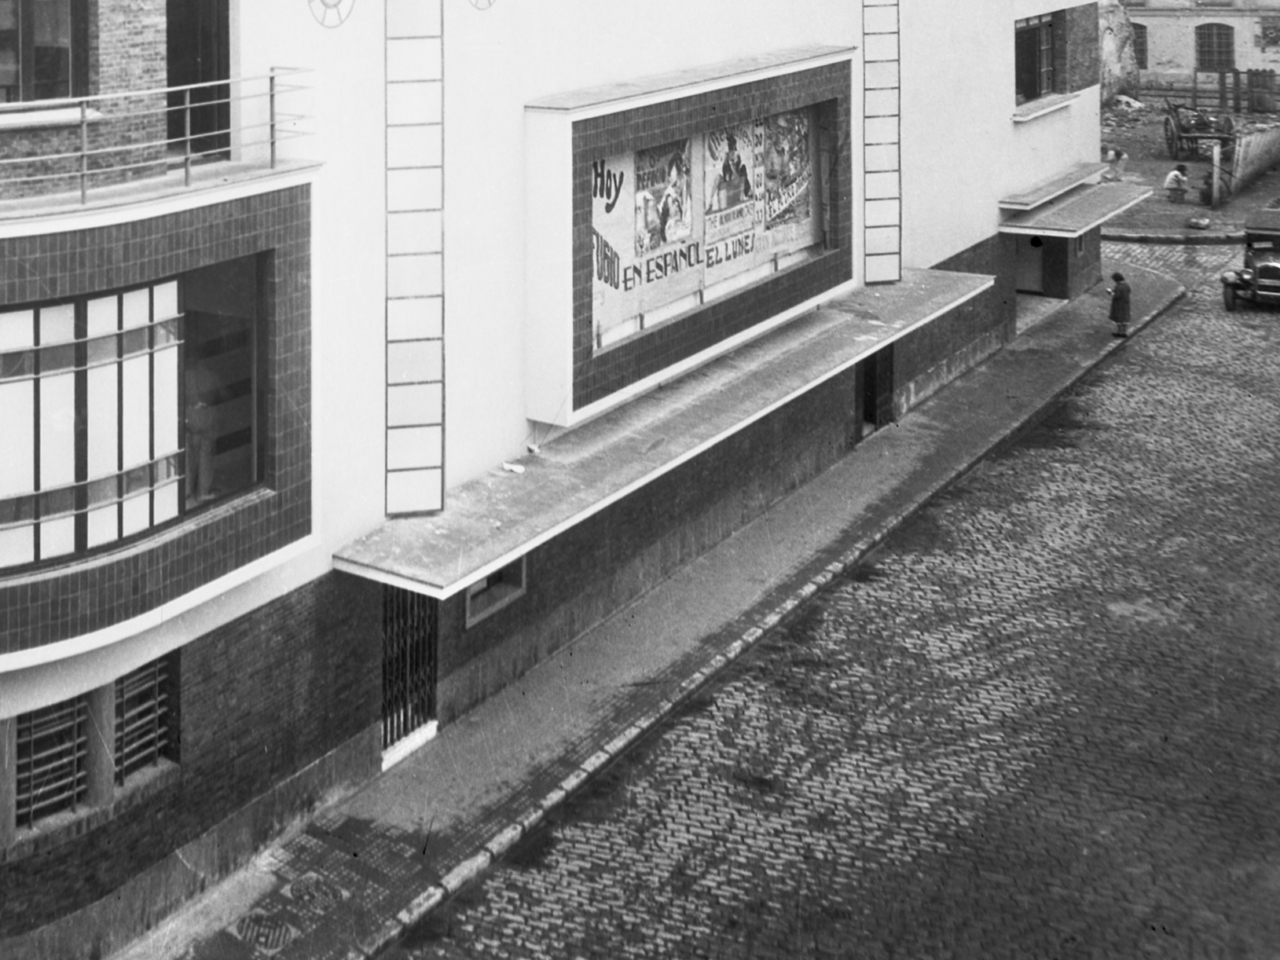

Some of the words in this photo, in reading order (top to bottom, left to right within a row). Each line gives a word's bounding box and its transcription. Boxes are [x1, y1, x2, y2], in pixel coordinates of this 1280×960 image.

[592, 159, 624, 214] Hoy
[623, 262, 642, 292] EN
[646, 240, 704, 284] ESPAÑOL
[705, 246, 722, 268] EL
